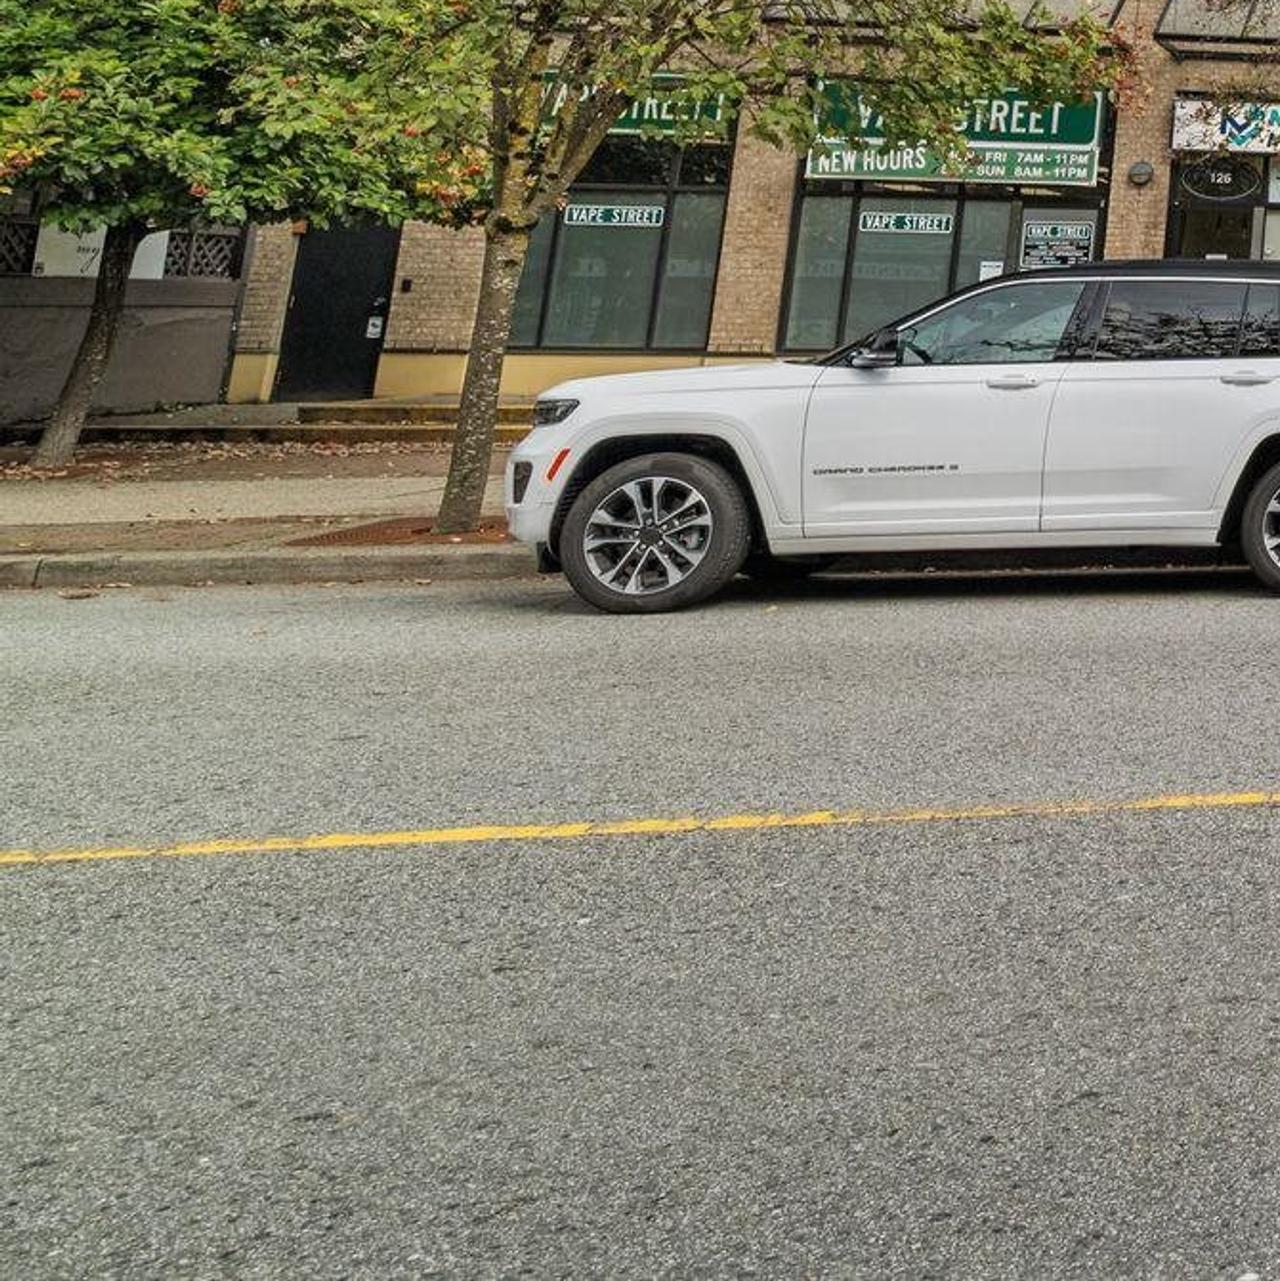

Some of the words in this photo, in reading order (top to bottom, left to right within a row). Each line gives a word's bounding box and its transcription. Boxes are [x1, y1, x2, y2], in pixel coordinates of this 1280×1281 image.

[818, 150, 859, 173] NEW
[863, 147, 927, 172] HOURS
[985, 152, 1008, 163] FRI
[1016, 152, 1044, 163] 7AM
[1055, 153, 1090, 165] 11PM
[976, 165, 1006, 177] SUN
[1014, 166, 1042, 177] 8AM
[1055, 167, 1088, 178] 11PM
[572, 207, 605, 223] VAPE
[611, 208, 660, 224] STREET
[865, 214, 897, 230] VAPE
[903, 216, 948, 231] STREET
